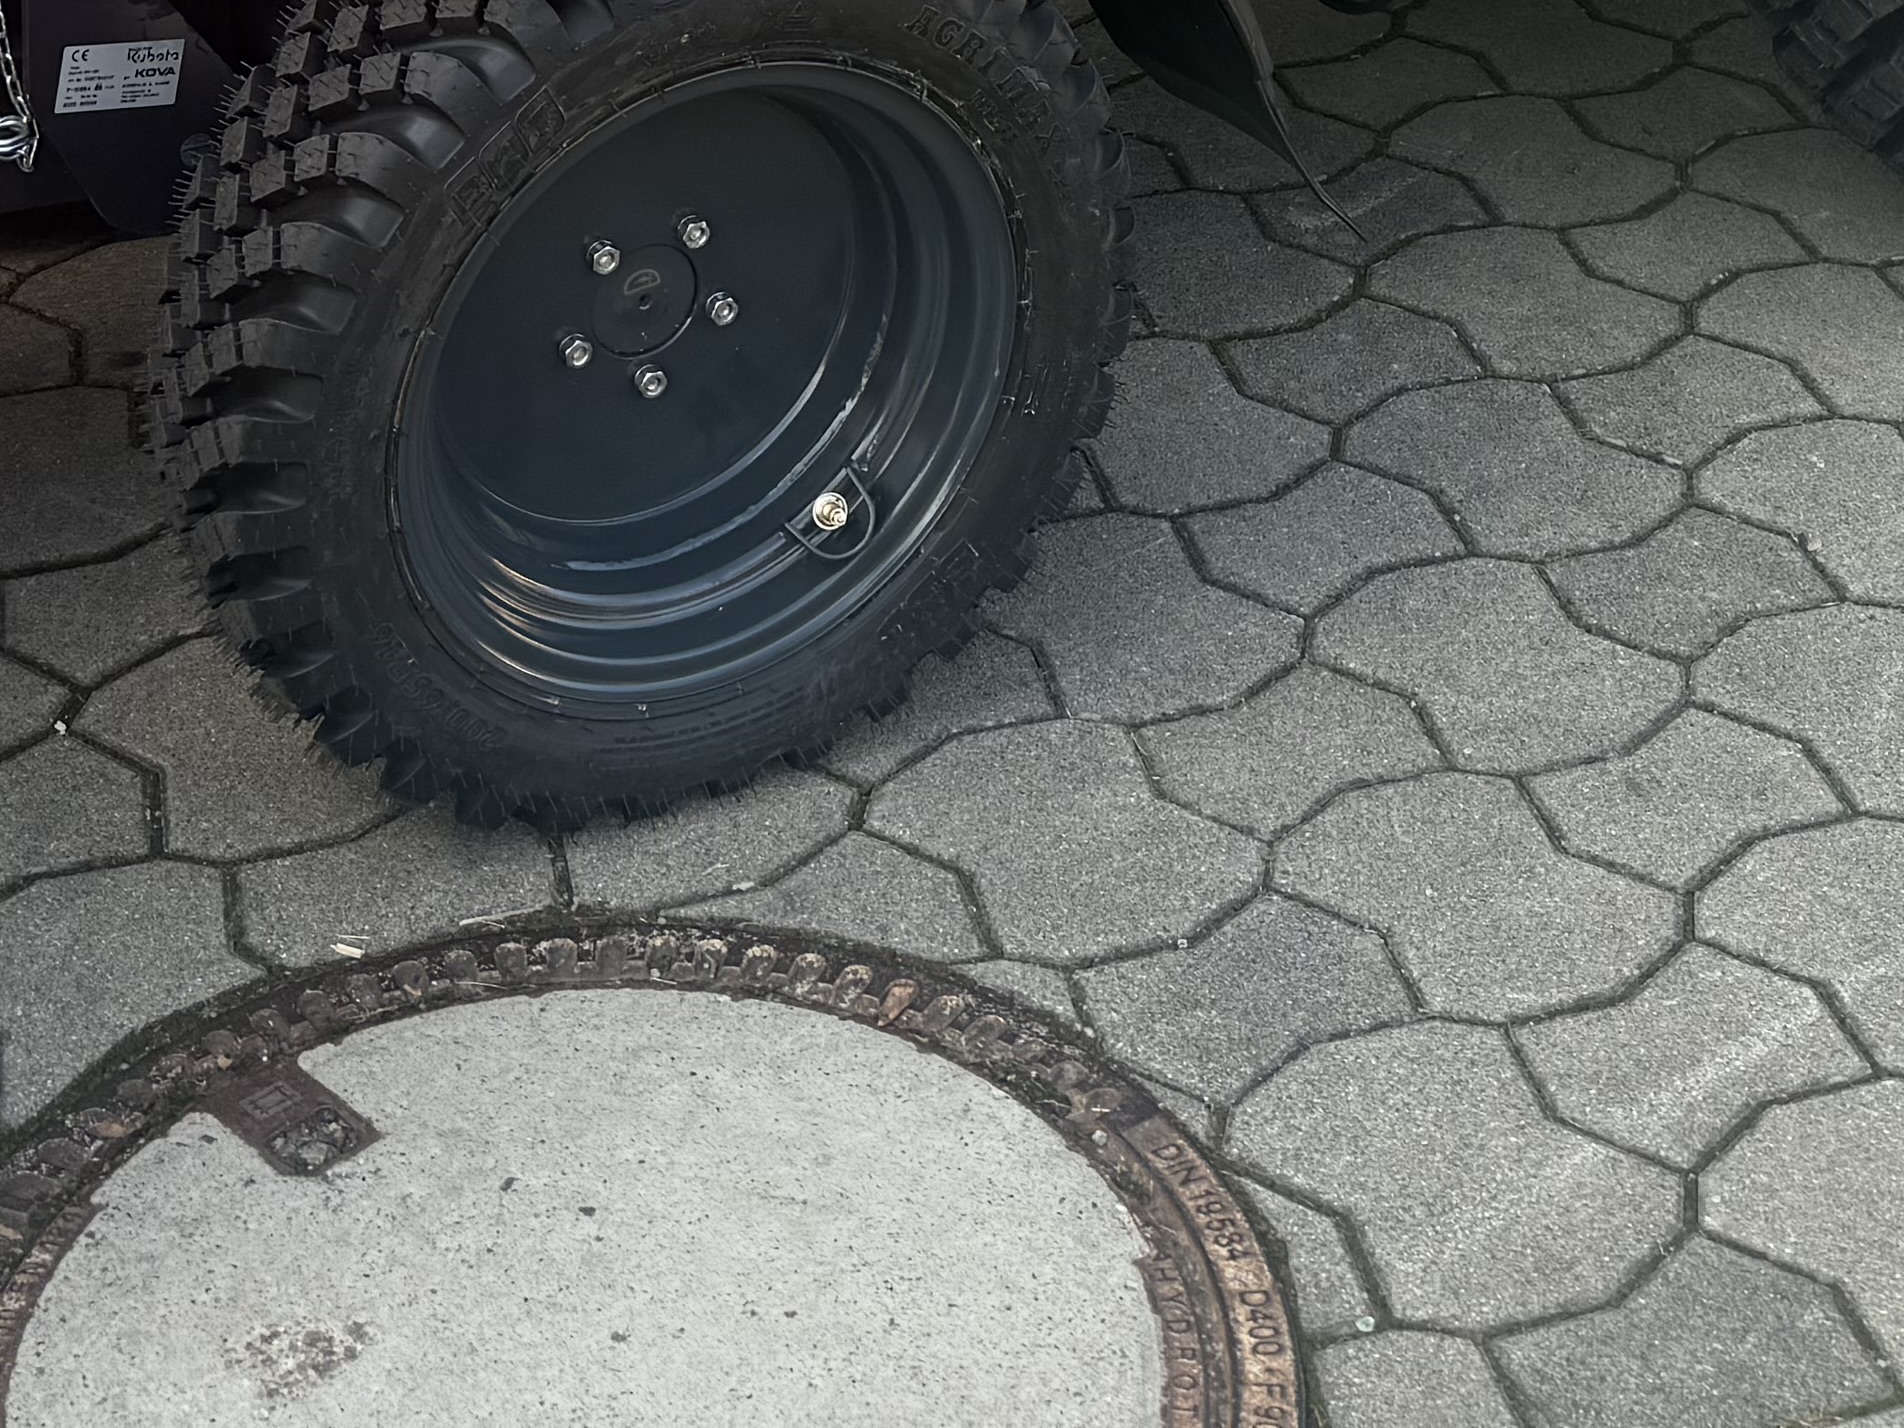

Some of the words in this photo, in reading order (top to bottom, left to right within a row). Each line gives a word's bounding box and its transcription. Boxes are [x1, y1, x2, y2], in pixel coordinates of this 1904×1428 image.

[71, 49, 90, 62] CE
[127, 46, 179, 64] Kubota
[134, 67, 176, 78] KOVA
[1150, 1141, 1198, 1196] DIN
[1188, 1186, 1252, 1262] 19584
[1238, 1289, 1280, 1356] D400
